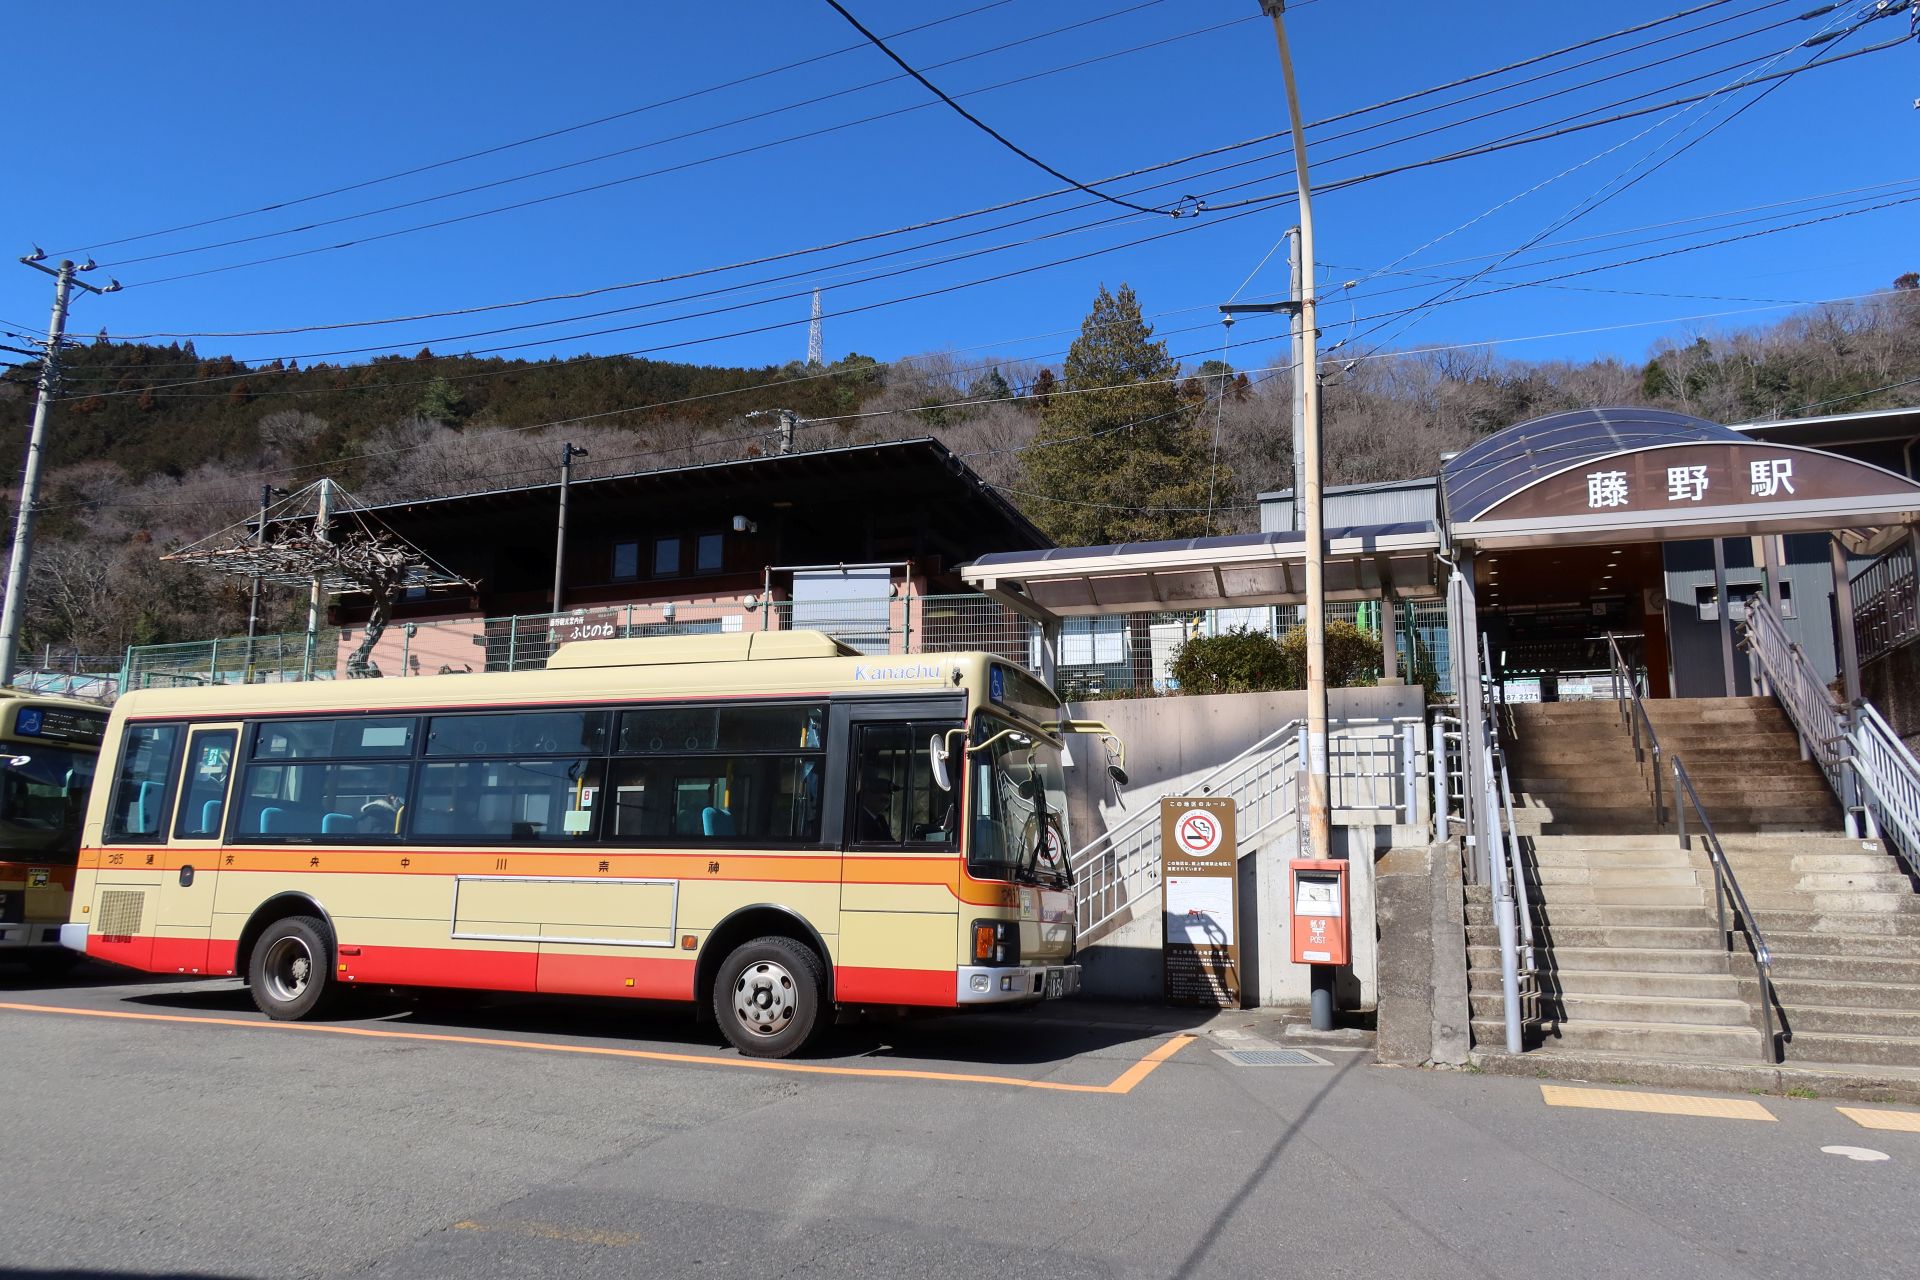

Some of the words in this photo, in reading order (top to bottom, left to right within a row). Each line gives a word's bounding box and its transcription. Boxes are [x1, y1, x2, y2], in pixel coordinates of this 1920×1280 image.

[1586, 458, 1796, 508] 藤野駅
[570, 622, 614, 639] ふじのね
[855, 663, 940, 681] Kanachu
[1309, 936, 1328, 944] POST
